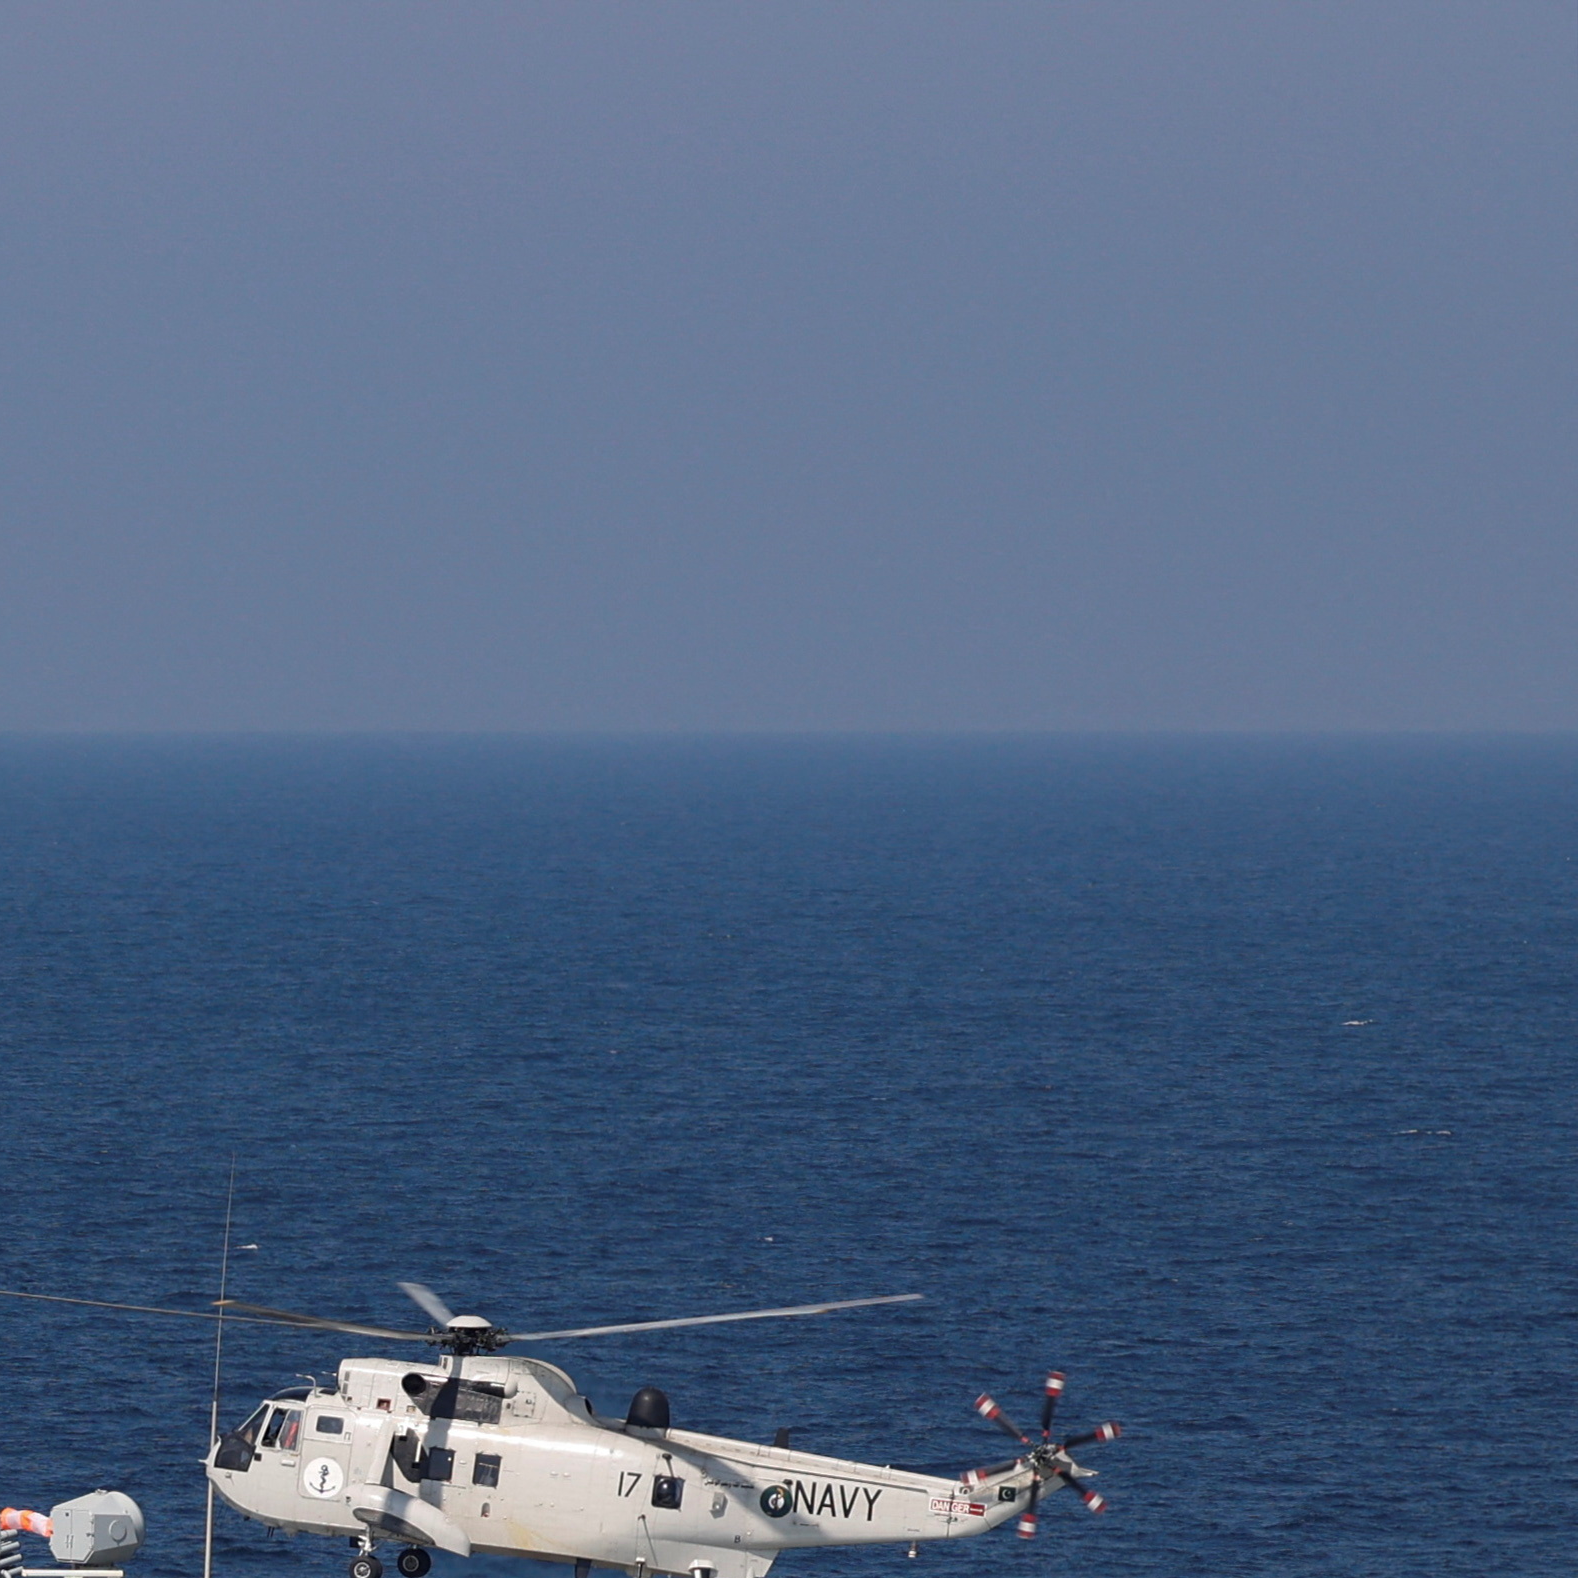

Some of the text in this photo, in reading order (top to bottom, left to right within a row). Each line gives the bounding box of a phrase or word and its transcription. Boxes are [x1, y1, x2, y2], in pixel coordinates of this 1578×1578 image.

[617, 1471, 642, 1498] 17
[793, 1480, 882, 1522] NAVY
[932, 1500, 970, 1515] DANGER
